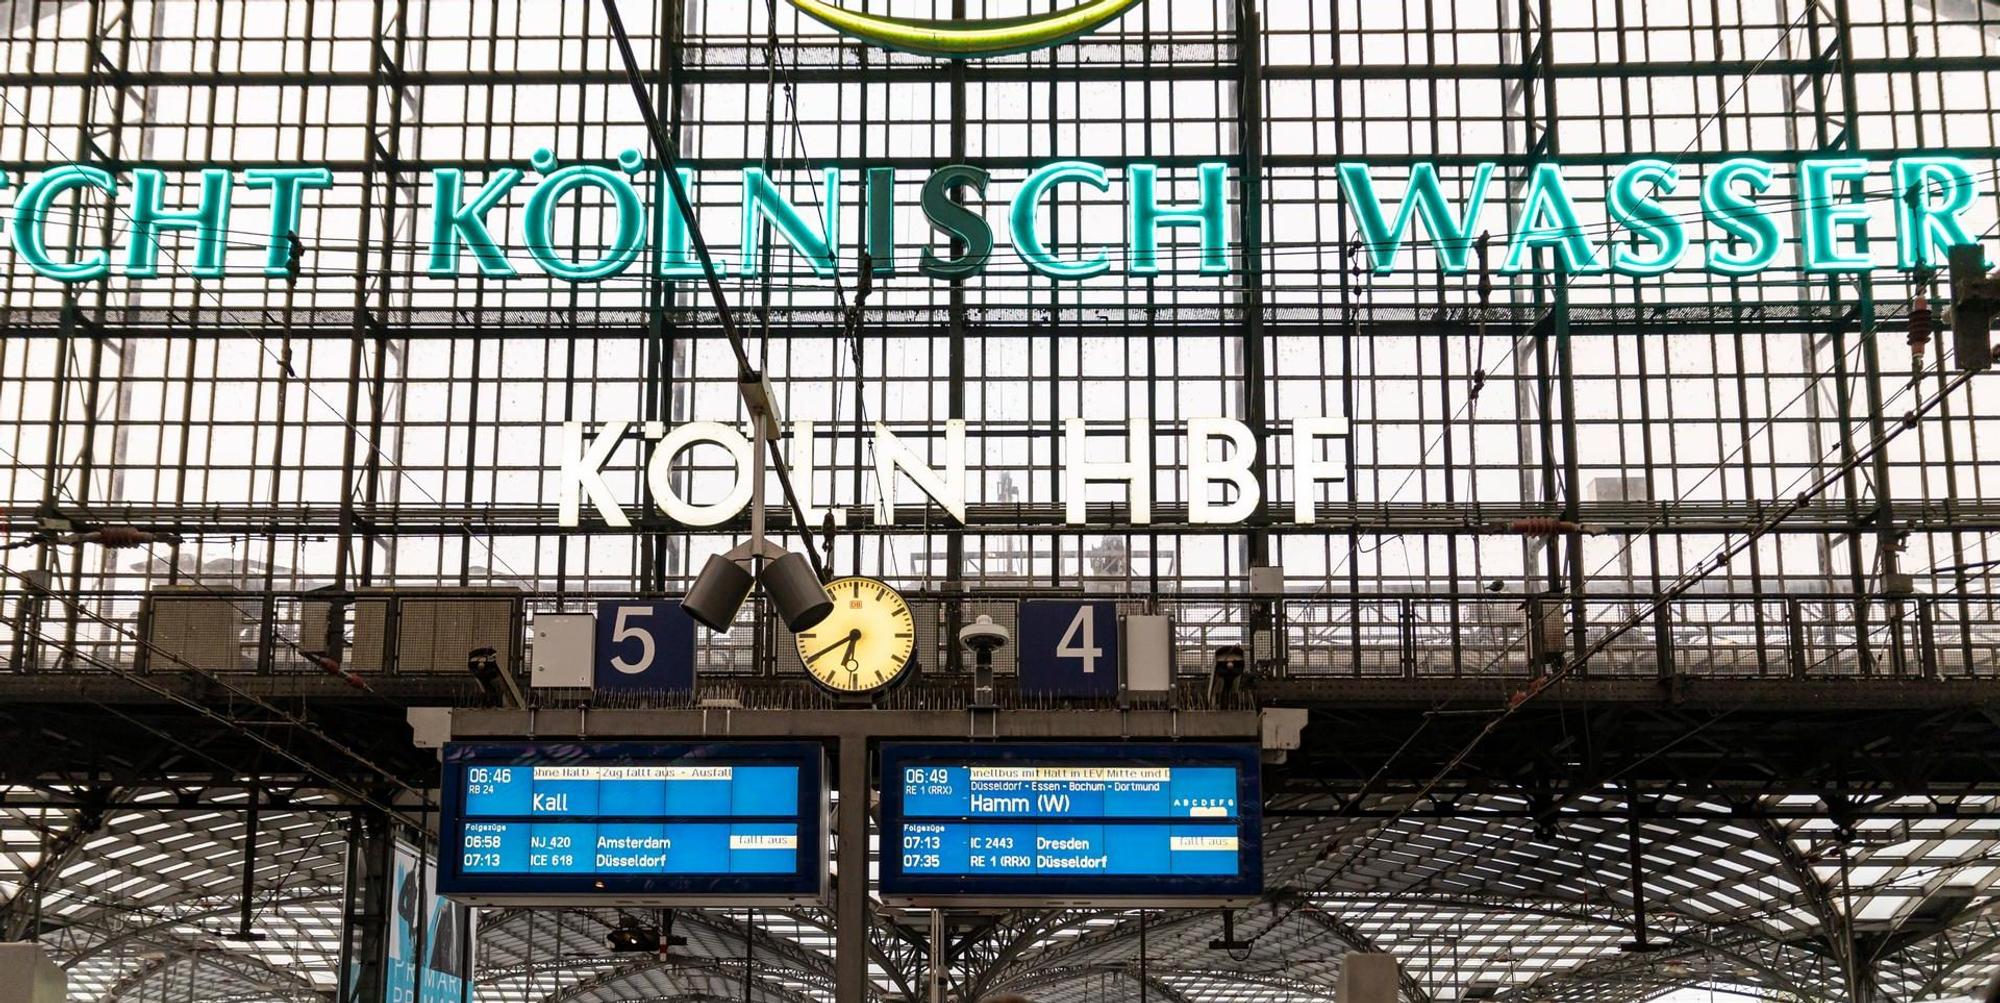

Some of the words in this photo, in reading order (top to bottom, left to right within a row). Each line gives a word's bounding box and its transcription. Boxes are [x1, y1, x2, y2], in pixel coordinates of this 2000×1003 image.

[0, 164, 333, 283] CHT
[428, 147, 1230, 282] KÖLNISCH
[1336, 156, 1994, 276] WASSER
[559, 416, 967, 527] KÖLN
[1065, 416, 1349, 526] HBF
[611, 606, 656, 674] 5
[1056, 605, 1103, 673] 4
[469, 768, 512, 784] 06:46
[655, 769, 675, 778] aus
[906, 768, 948, 784] 06:49
[1106, 769, 1137, 779] Mitte
[1139, 769, 1160, 779] und
[468, 785, 481, 795] RB
[482, 785, 494, 795] 24
[905, 785, 917, 795] RE
[920, 785, 926, 795] 1
[928, 785, 953, 796] (RRX)
[970, 781, 1022, 791] Düsseldorf
[1031, 782, 1060, 791] Essen
[1069, 782, 1105, 791] Bochum
[1114, 782, 1160, 792] Dortmund
[532, 793, 568, 812] Kall
[970, 794, 1030, 812] Hamm
[1037, 794, 1070, 813] (W)
[465, 823, 507, 833] Folgezüge
[903, 823, 945, 833] Folgezüge
[464, 836, 501, 849] 06:58
[531, 836, 546, 849] NJ
[549, 836, 571, 849] 420
[597, 836, 671, 849] Amsterdam
[903, 836, 940, 849] 07:13
[970, 837, 981, 849] IC
[985, 837, 1014, 849] 2443
[1036, 837, 1090, 850] Dresden
[463, 853, 500, 867] 07:13
[530, 854, 548, 867] ICE
[551, 854, 573, 867] 618
[596, 854, 667, 868] Düsseldorf
[903, 854, 940, 867] 07:35
[970, 855, 985, 867] RE
[990, 855, 997, 867] 1
[1000, 855, 1031, 867] (RRX)
[1036, 855, 1108, 868] Düsseldorf
